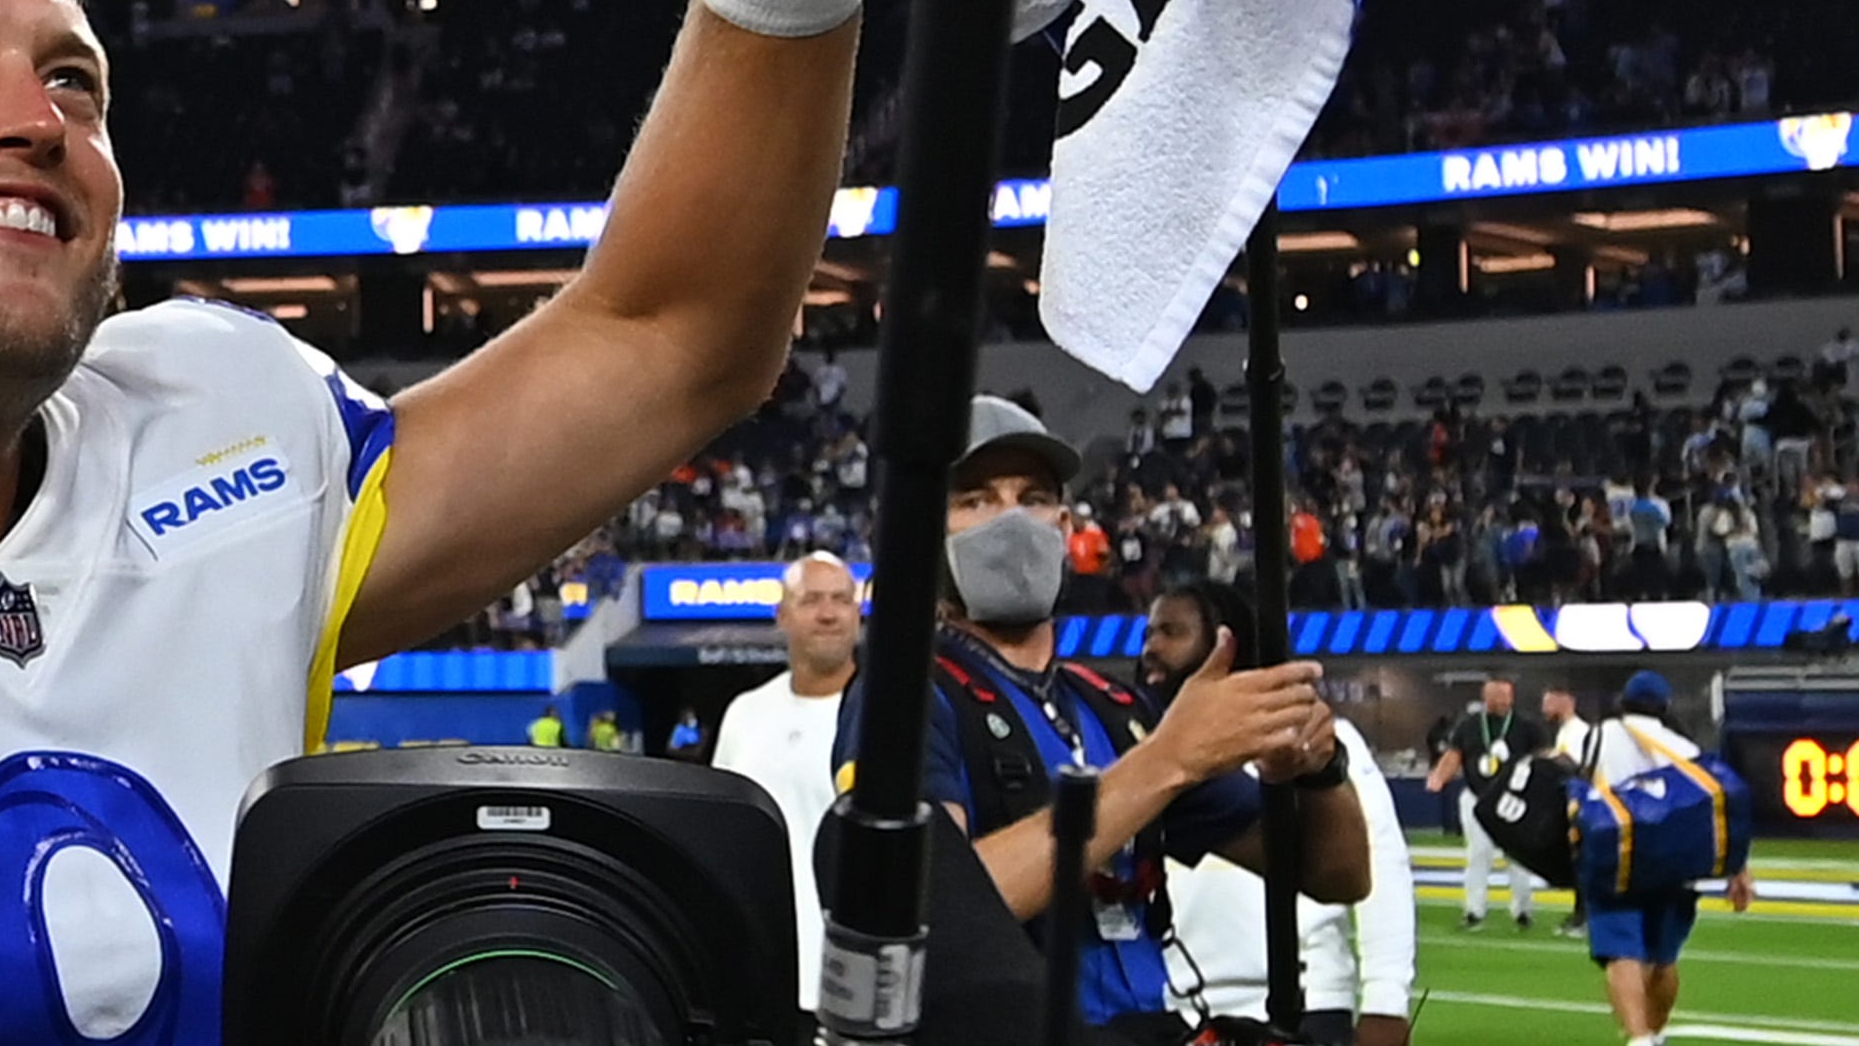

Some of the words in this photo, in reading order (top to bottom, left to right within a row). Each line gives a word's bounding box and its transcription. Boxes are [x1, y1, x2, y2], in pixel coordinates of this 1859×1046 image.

[1442, 147, 1567, 192] RAMS
[1577, 136, 1680, 180] WIN!
[114, 220, 194, 253] AMS
[201, 217, 290, 251] WIN!
[516, 207, 607, 242] RAM
[141, 458, 285, 536] RAMS
[670, 578, 783, 606] RAMS
[455, 752, 571, 767] Canon
